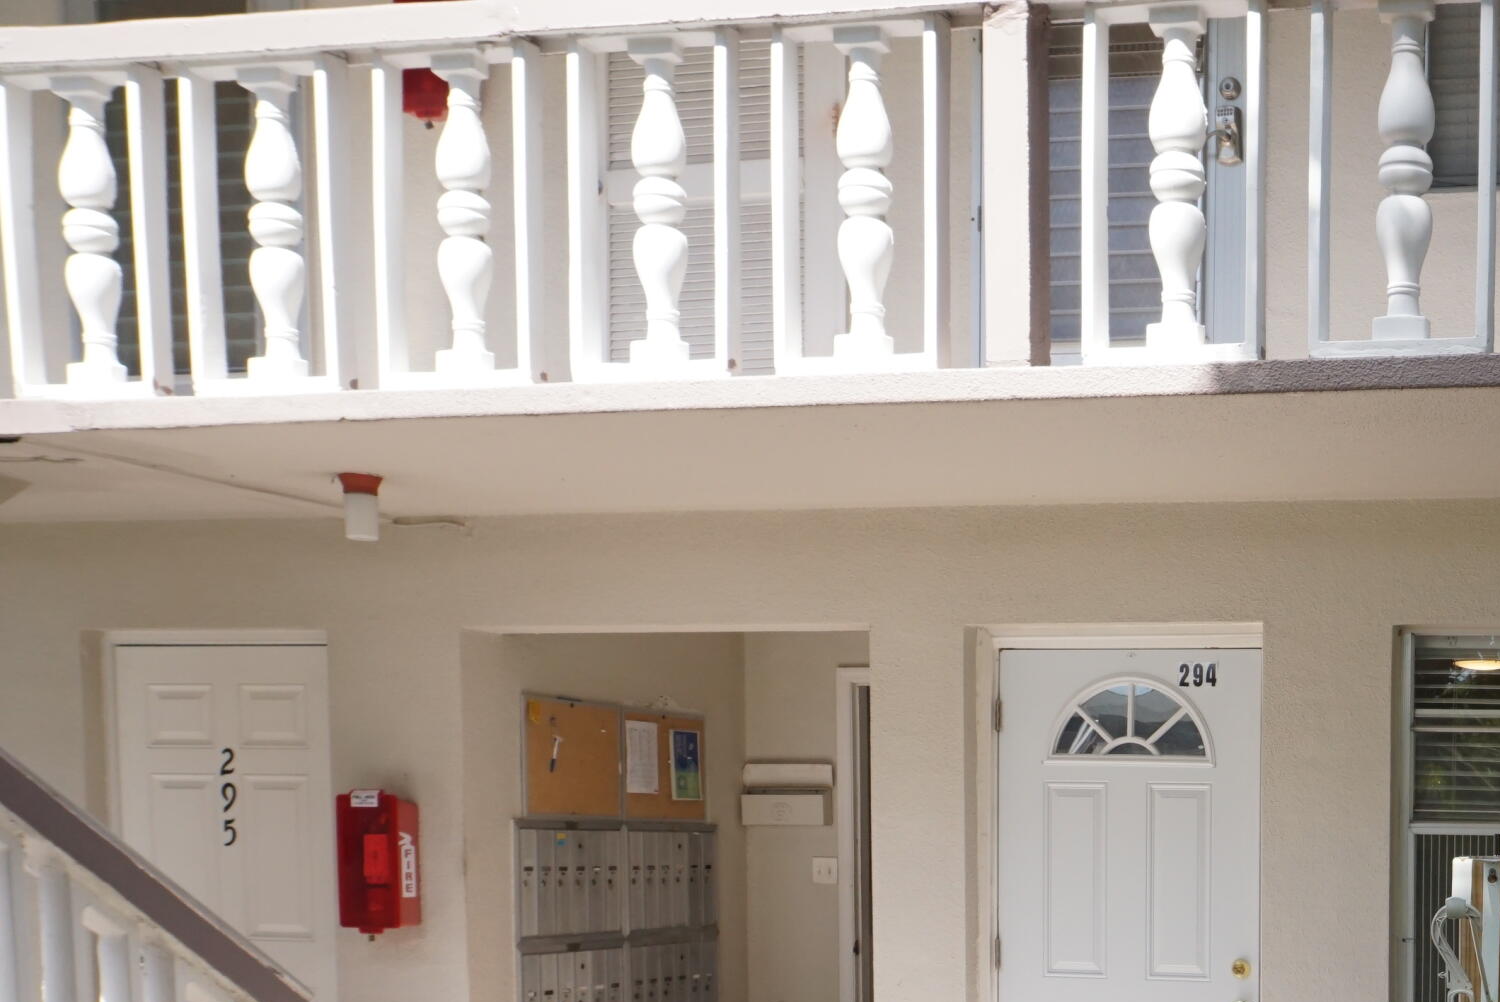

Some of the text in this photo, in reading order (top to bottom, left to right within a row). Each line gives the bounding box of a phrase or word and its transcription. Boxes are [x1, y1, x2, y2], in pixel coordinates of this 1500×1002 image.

[1178, 663, 1217, 687] 294
[220, 748, 237, 847] 295
[404, 848, 413, 893] FIRE
